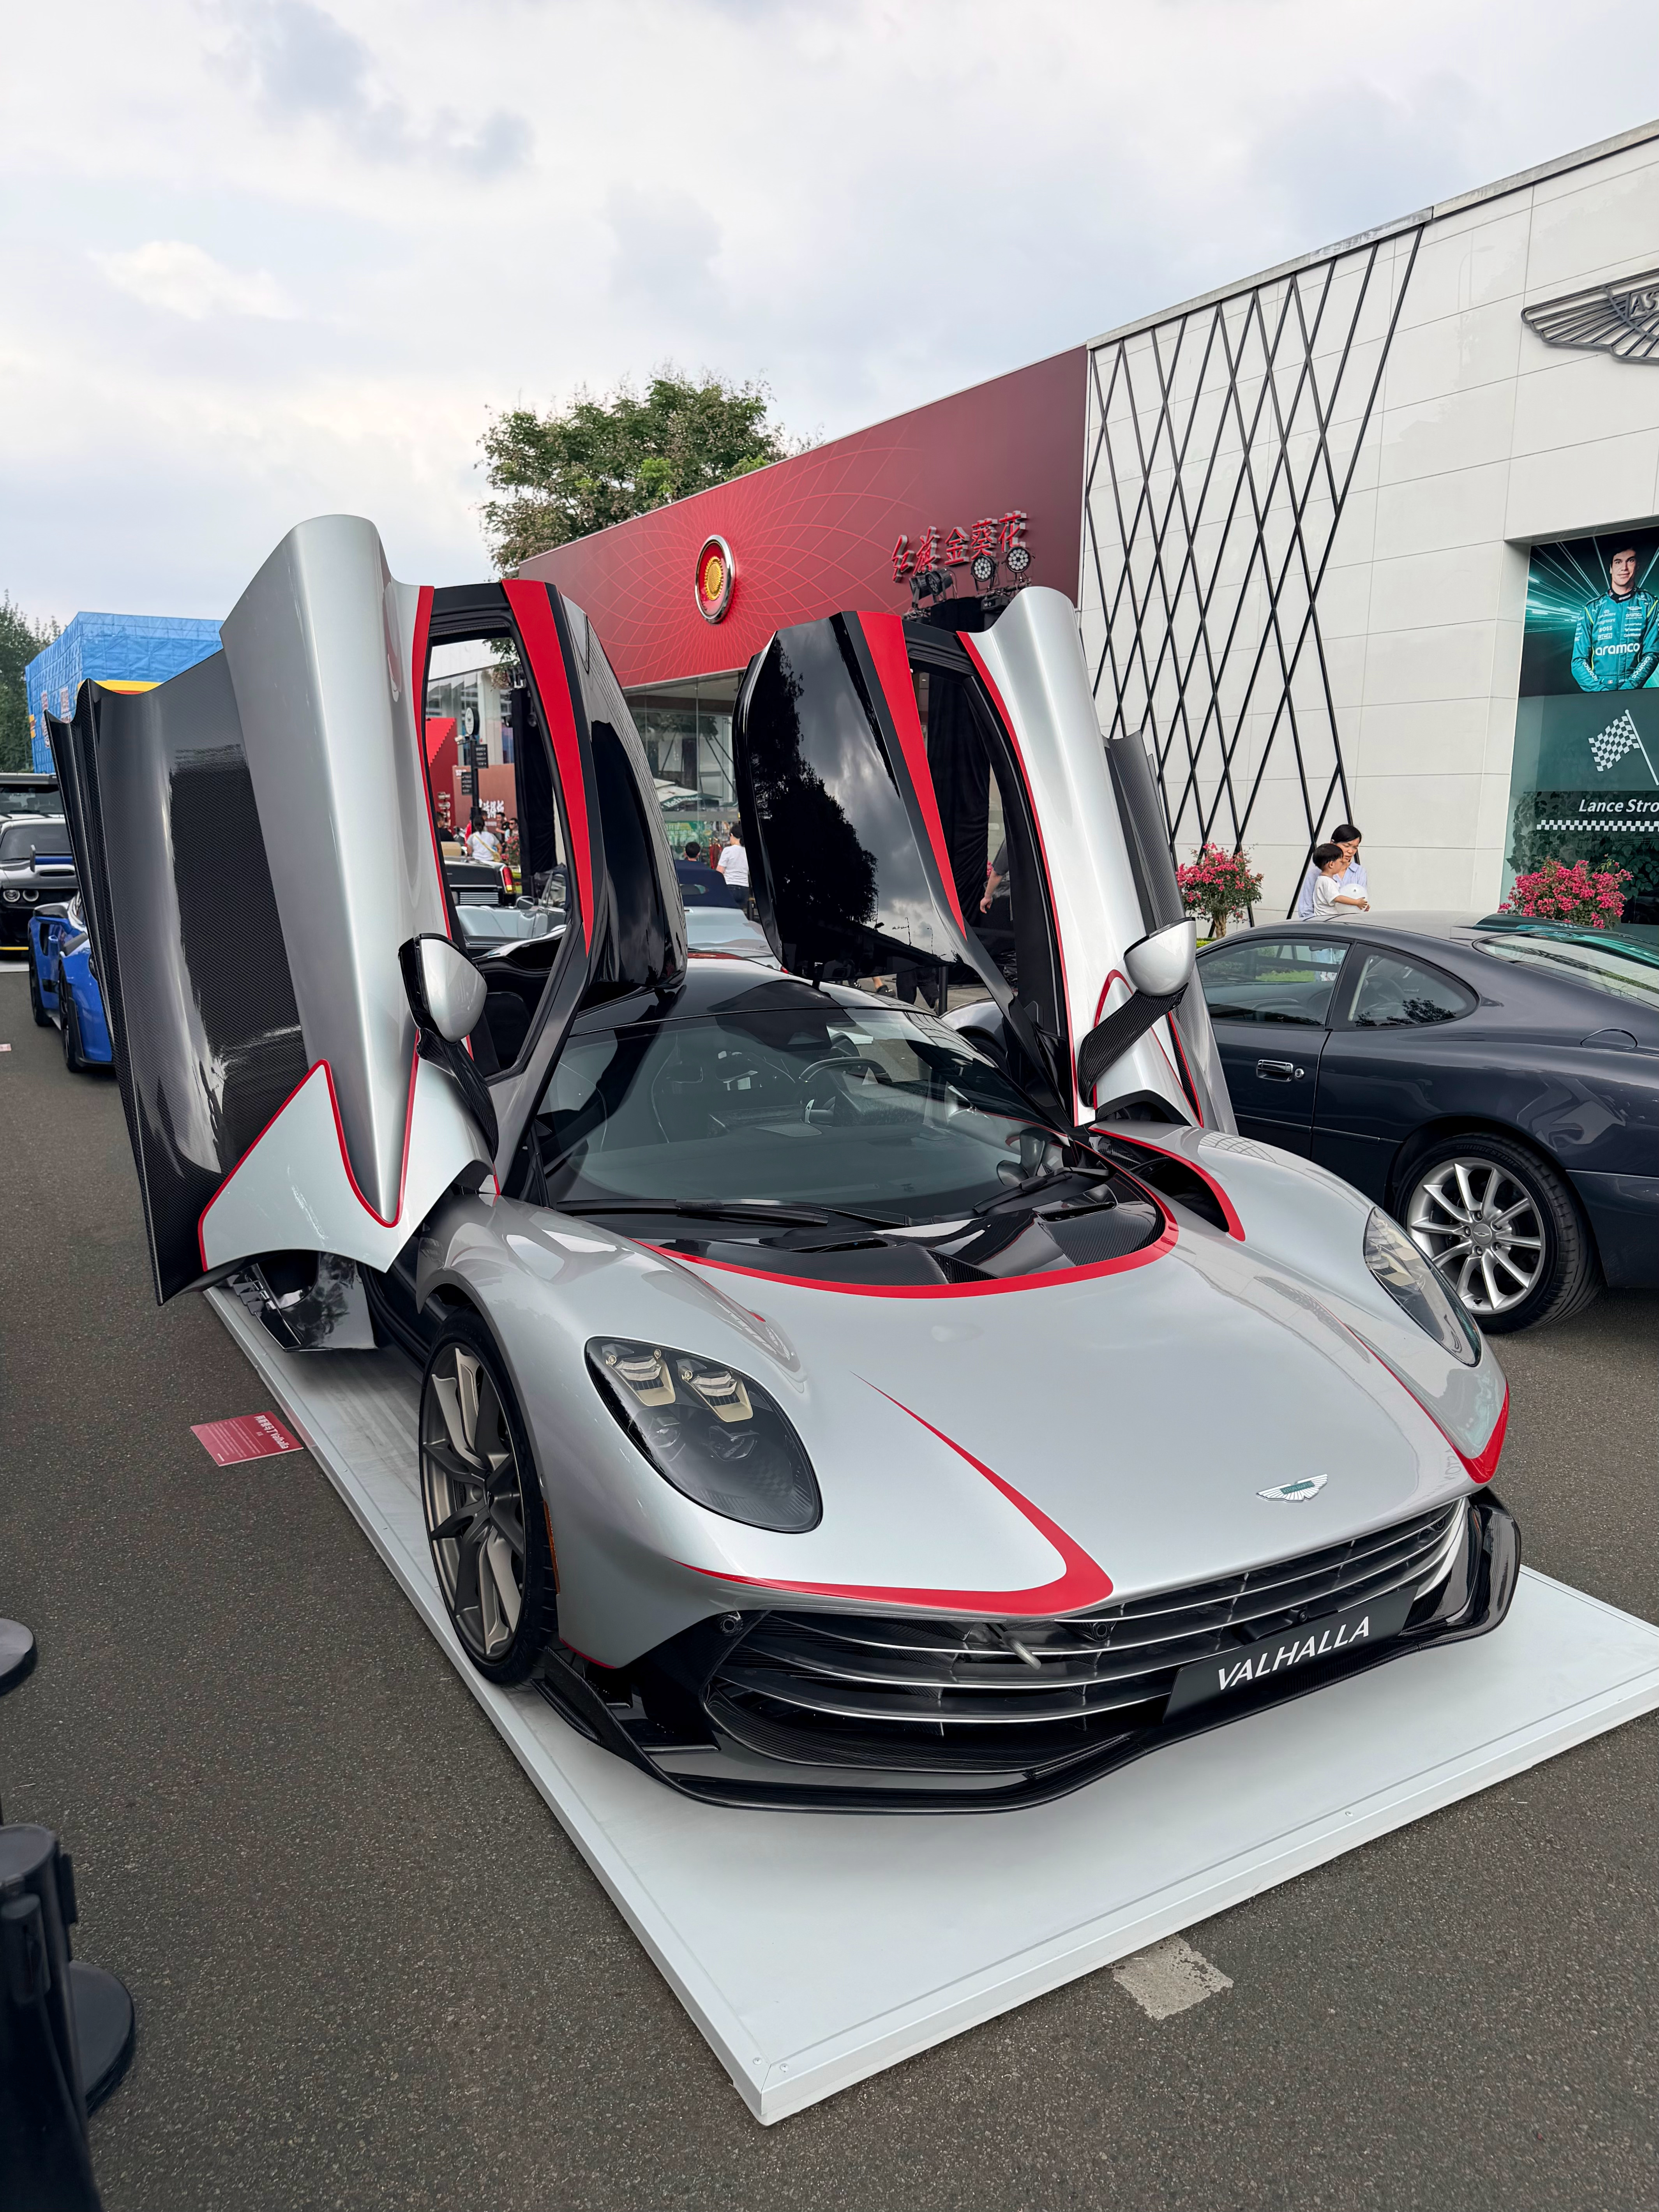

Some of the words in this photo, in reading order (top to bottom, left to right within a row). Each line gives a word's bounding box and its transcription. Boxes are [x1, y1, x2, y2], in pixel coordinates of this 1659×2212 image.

[1630, 290, 1659, 315] AS
[1595, 643, 1640, 656] aramco
[1579, 799, 1624, 812] Lance
[1626, 799, 1659, 812] Stro
[1218, 1616, 1369, 1690] VALHALLA
